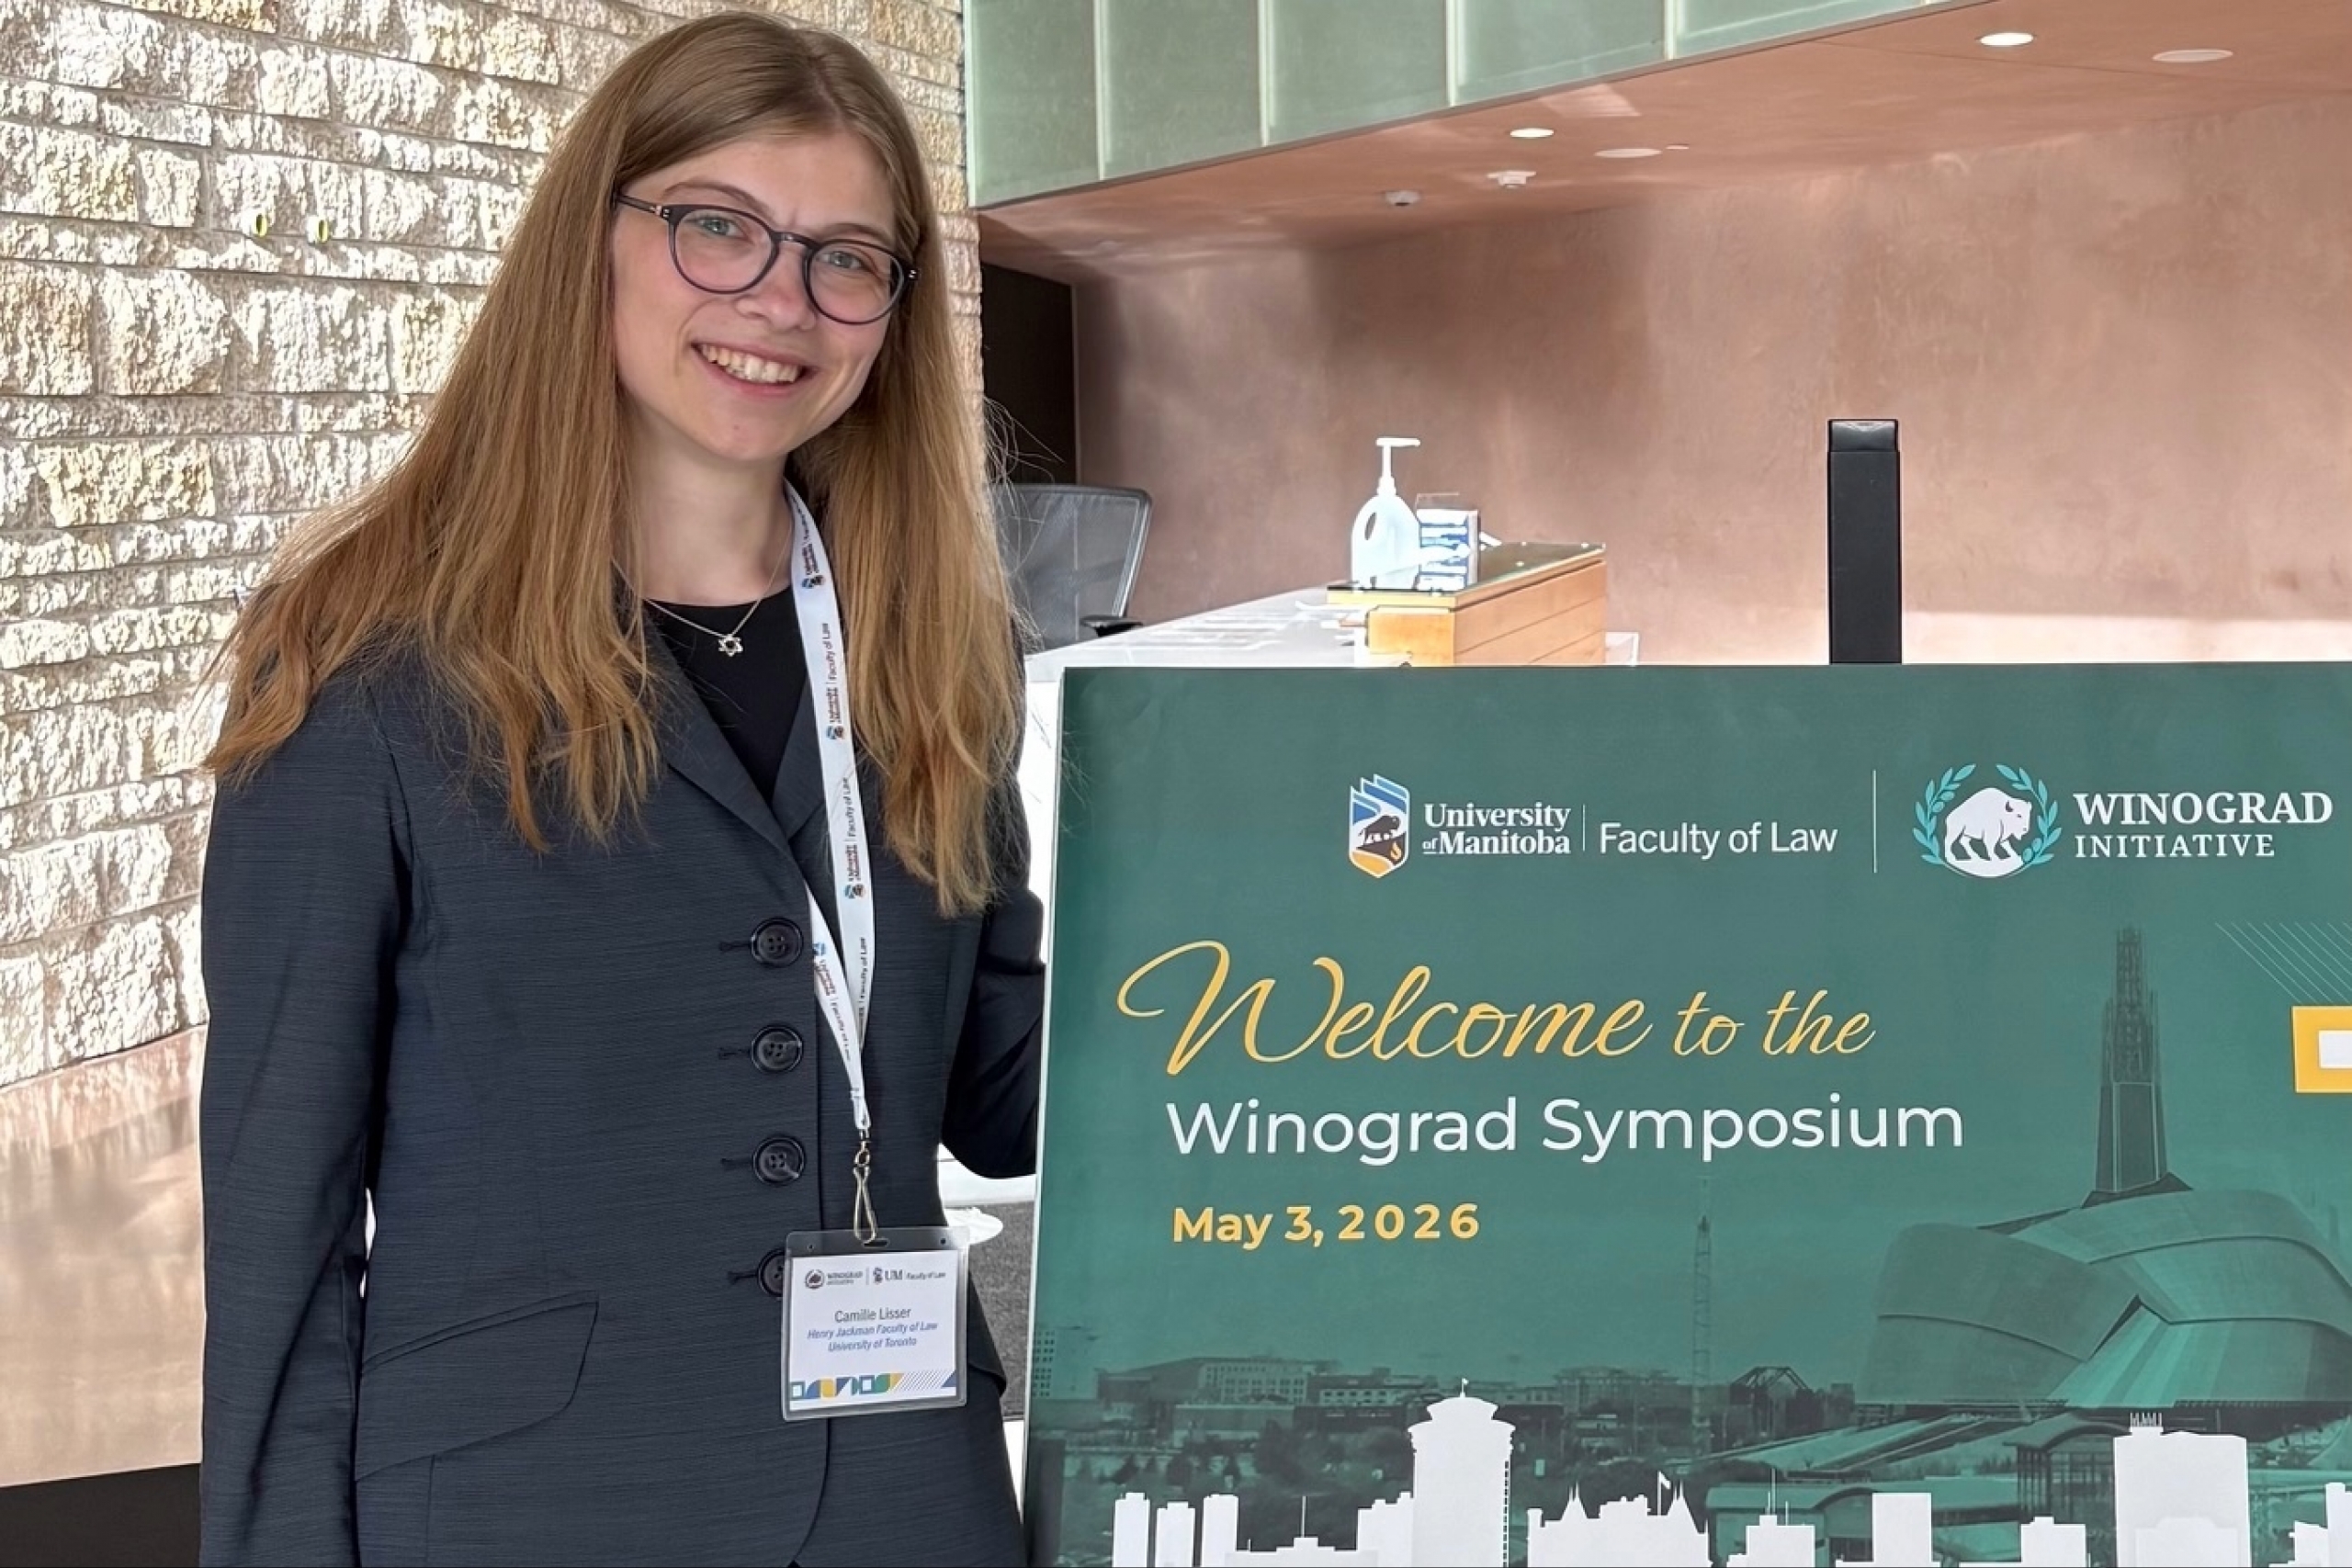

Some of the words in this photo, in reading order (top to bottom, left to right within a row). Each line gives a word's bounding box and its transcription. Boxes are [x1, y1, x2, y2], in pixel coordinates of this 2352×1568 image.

[1424, 803, 1571, 831] University
[2073, 791, 2333, 825] WINOGRAD
[1439, 830, 1571, 855] Manitoba
[1600, 822, 1714, 860] Faculty
[1728, 822, 1761, 852] of
[1770, 823, 1838, 852] Law
[2075, 834, 2275, 858] INITIATIVE
[1116, 940, 1653, 1076] Welcome
[1672, 991, 1744, 1056] to
[1762, 988, 1876, 1055] the
[1166, 1098, 1517, 1167] Winograd
[1542, 1093, 1964, 1163] Symposium
[1171, 1206, 1273, 1250] May
[1285, 1205, 1324, 1248] 3,
[1339, 1203, 1480, 1241] 2026
[879, 1307, 911, 1320] Lisser
[807, 1328, 833, 1339] Henry
[835, 1325, 876, 1337] Jackman
[876, 1324, 908, 1335] Faculty
[910, 1321, 920, 1332] of
[920, 1321, 938, 1331] Law
[828, 1339, 872, 1352] University
[872, 1338, 882, 1348] of
[884, 1336, 917, 1348] Toronto
